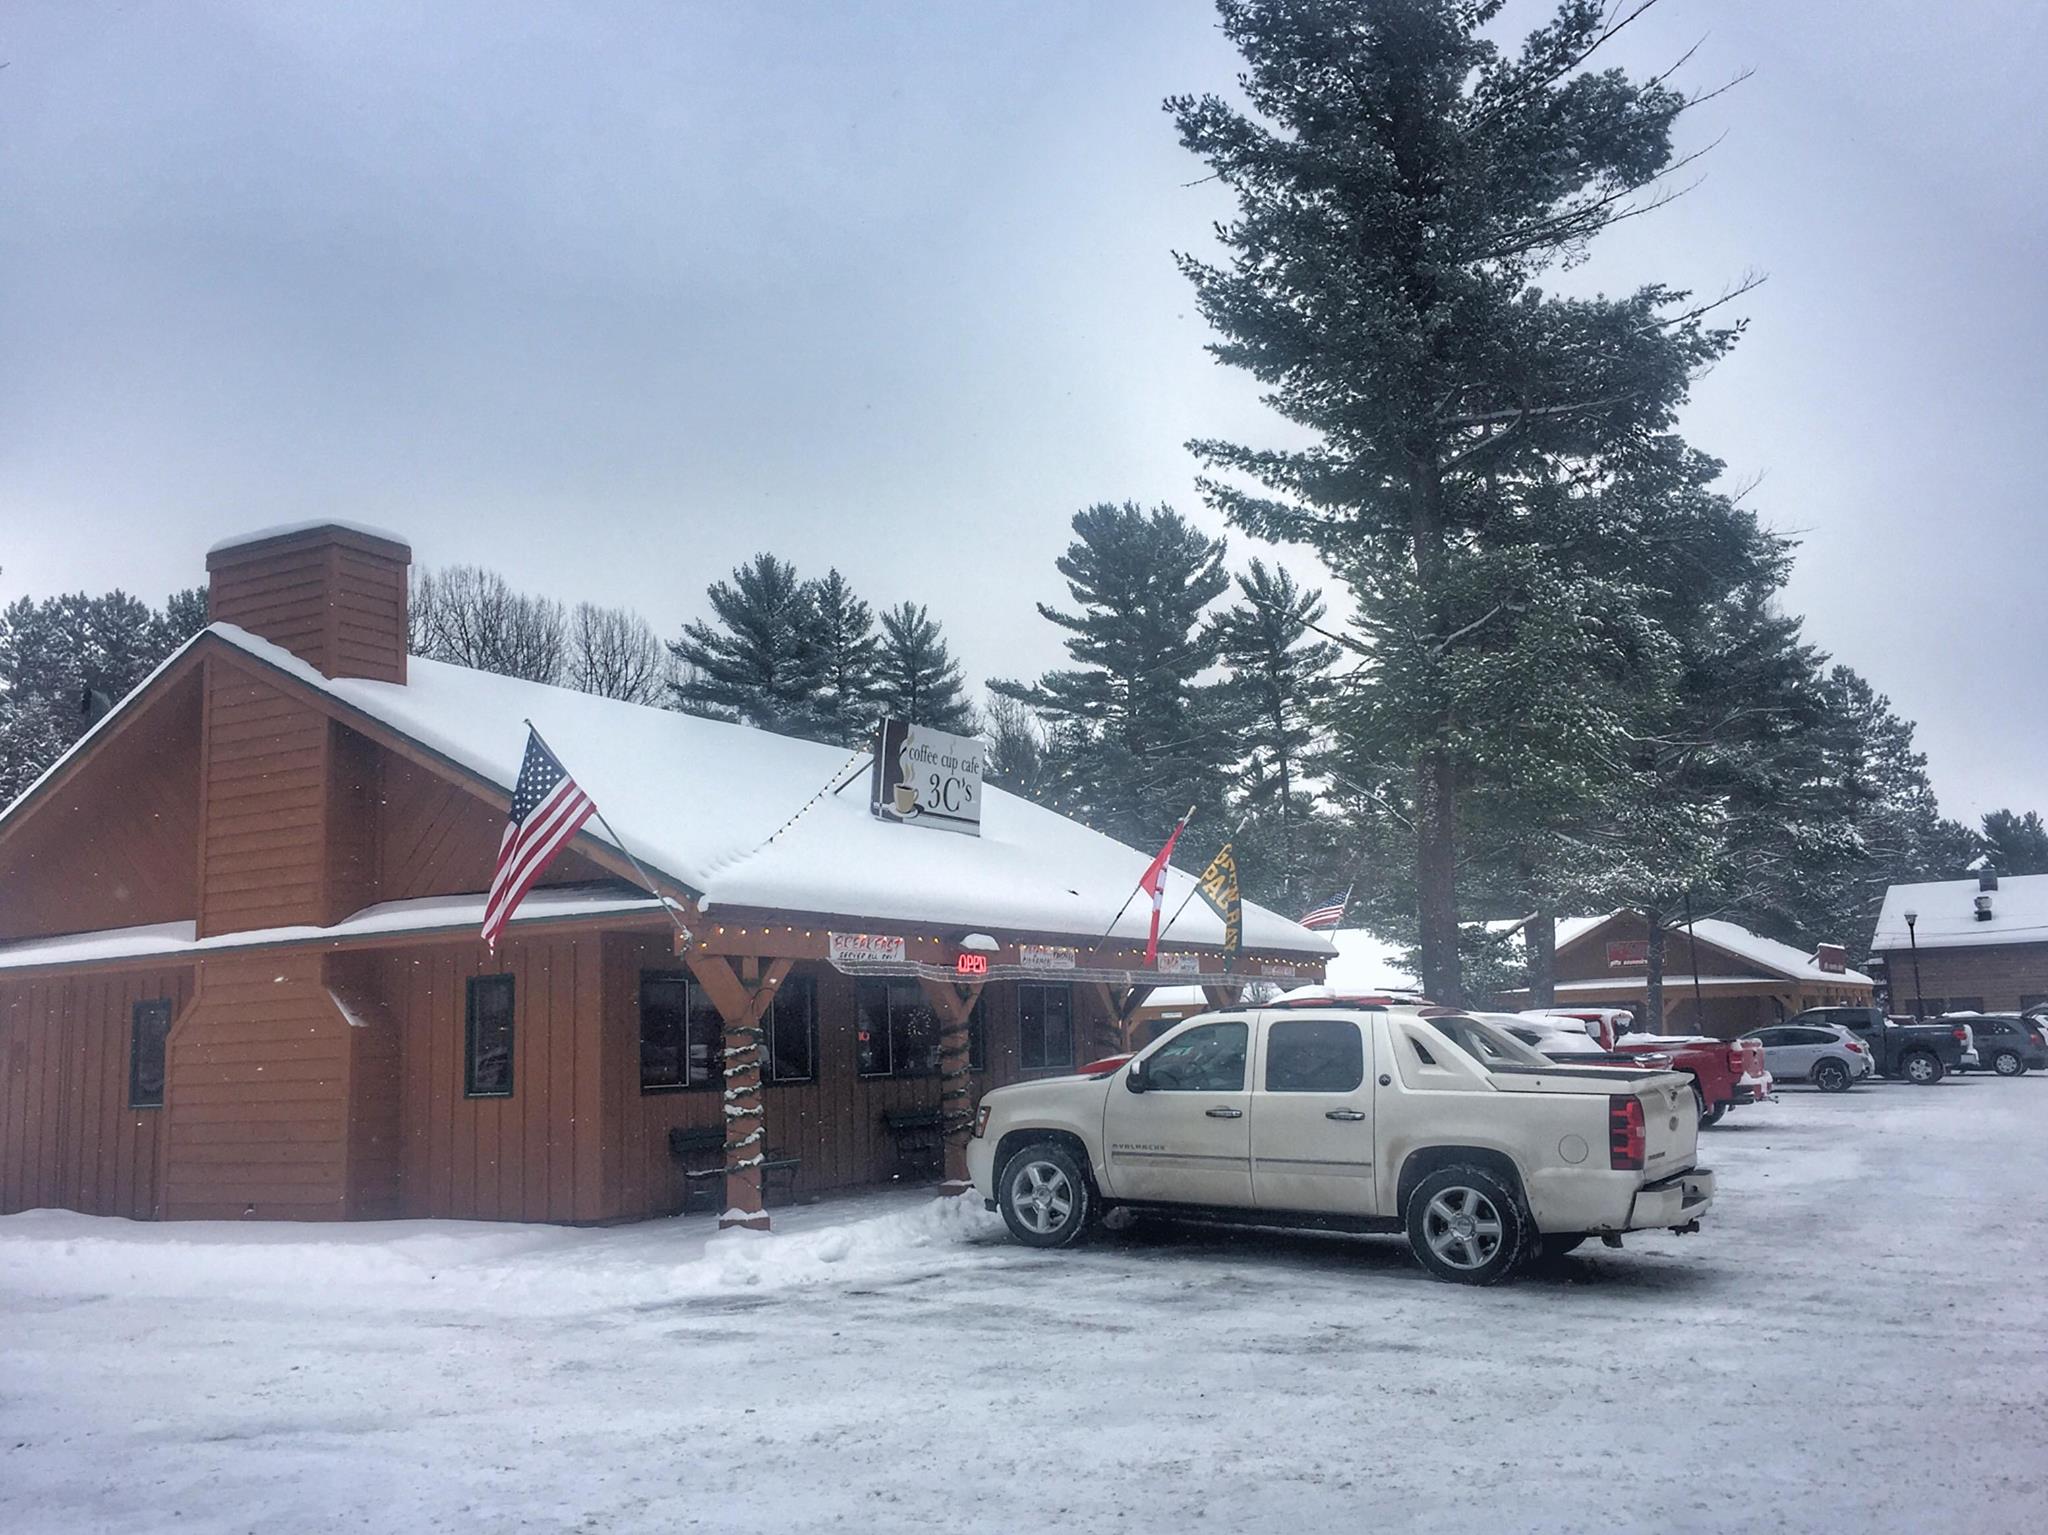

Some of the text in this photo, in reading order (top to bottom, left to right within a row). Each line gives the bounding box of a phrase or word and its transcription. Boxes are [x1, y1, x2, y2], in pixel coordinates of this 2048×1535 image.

[908, 744, 980, 775] coffee cup cafe
[927, 773, 972, 812] 3C's
[958, 954, 987, 973] OPEN
